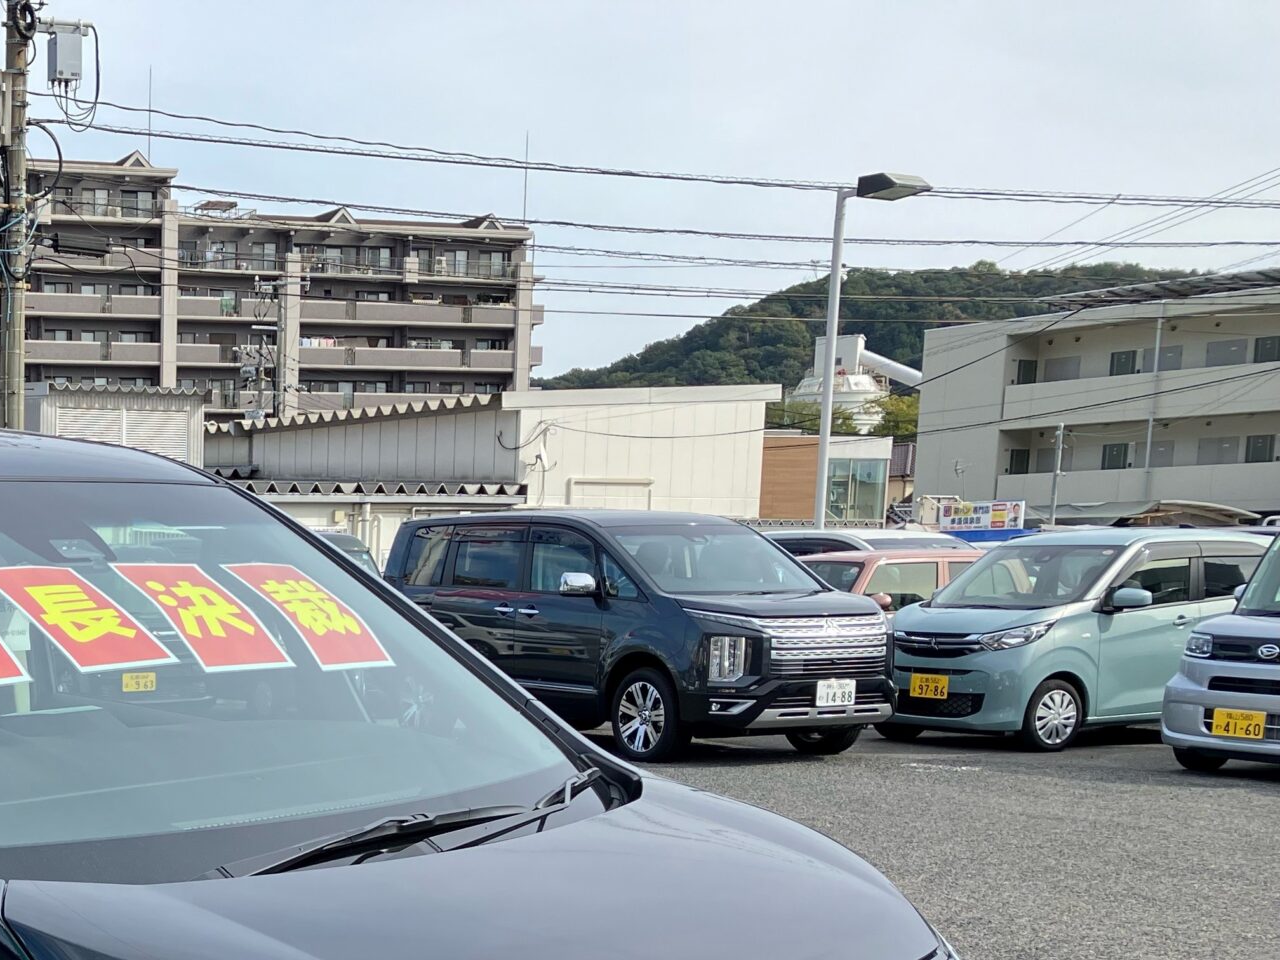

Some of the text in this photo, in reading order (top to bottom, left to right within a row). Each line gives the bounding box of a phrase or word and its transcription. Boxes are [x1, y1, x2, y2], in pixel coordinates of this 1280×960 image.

[825, 690, 853, 704] 14-88
[918, 683, 945, 697] 97-86
[1223, 721, 1261, 737] 41-60
